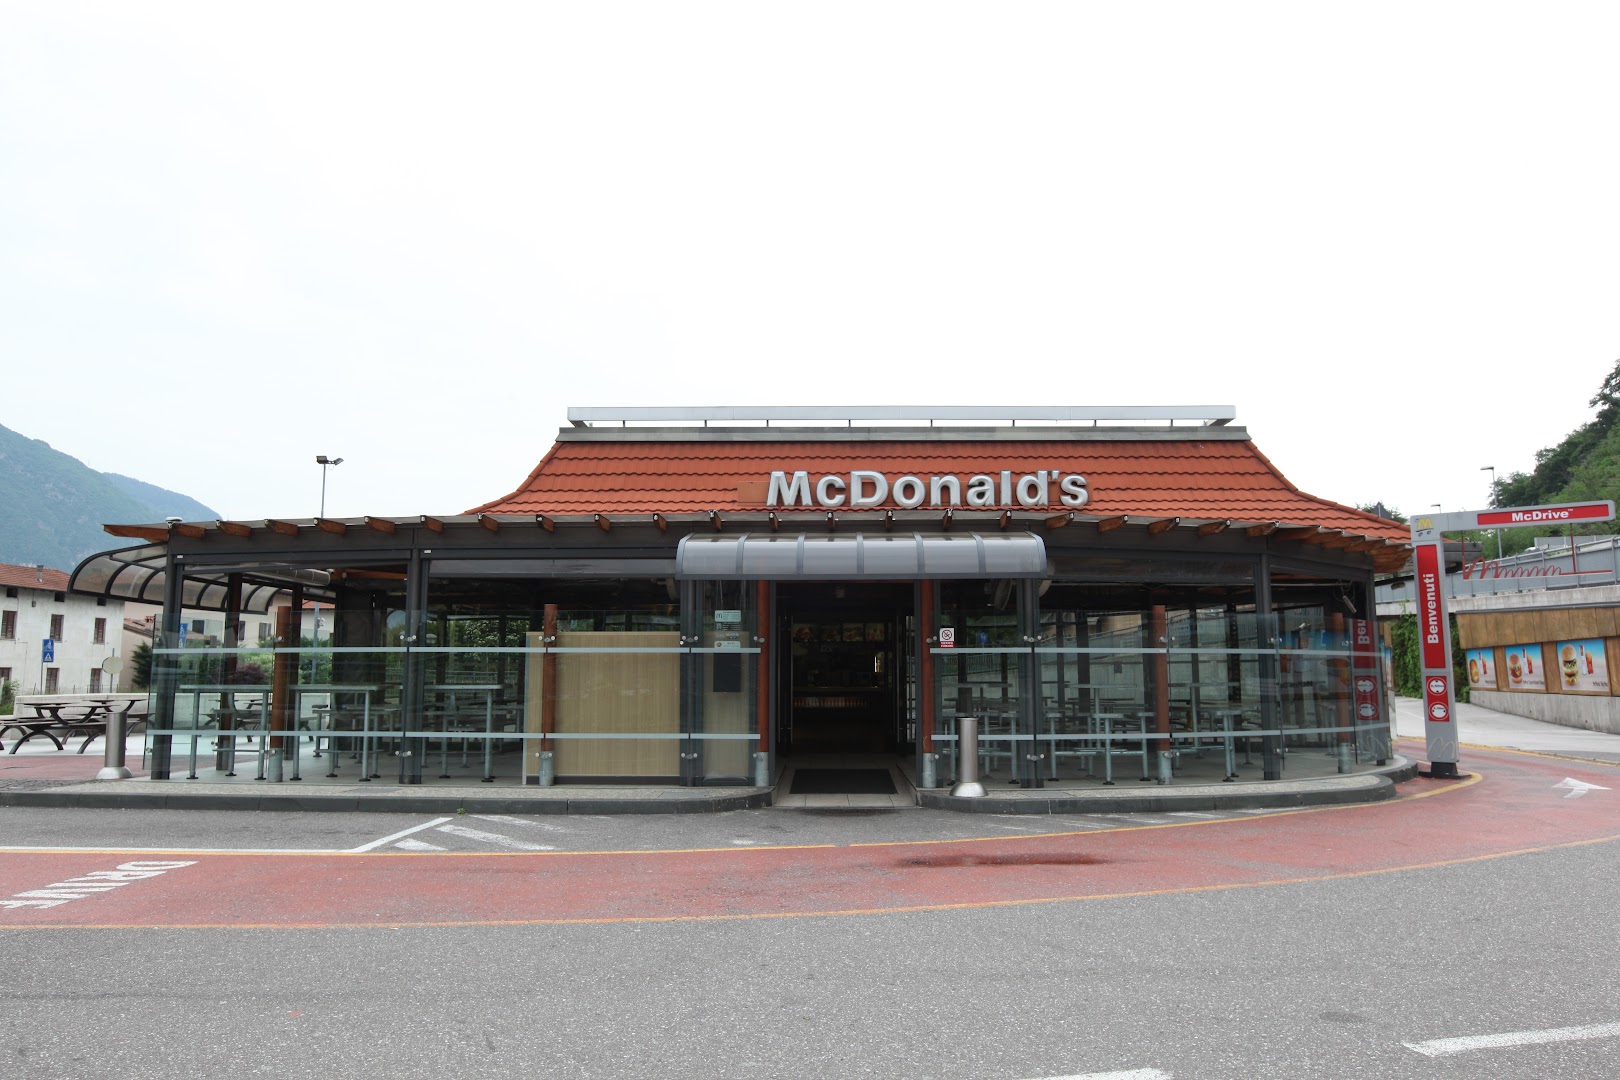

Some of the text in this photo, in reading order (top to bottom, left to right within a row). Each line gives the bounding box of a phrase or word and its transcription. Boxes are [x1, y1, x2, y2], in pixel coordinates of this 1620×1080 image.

[766, 470, 1089, 508] McDonald's
[1511, 510, 1569, 522] McDrive
[1422, 573, 1440, 644] Benvenuti
[0, 860, 200, 909] DRIVE
